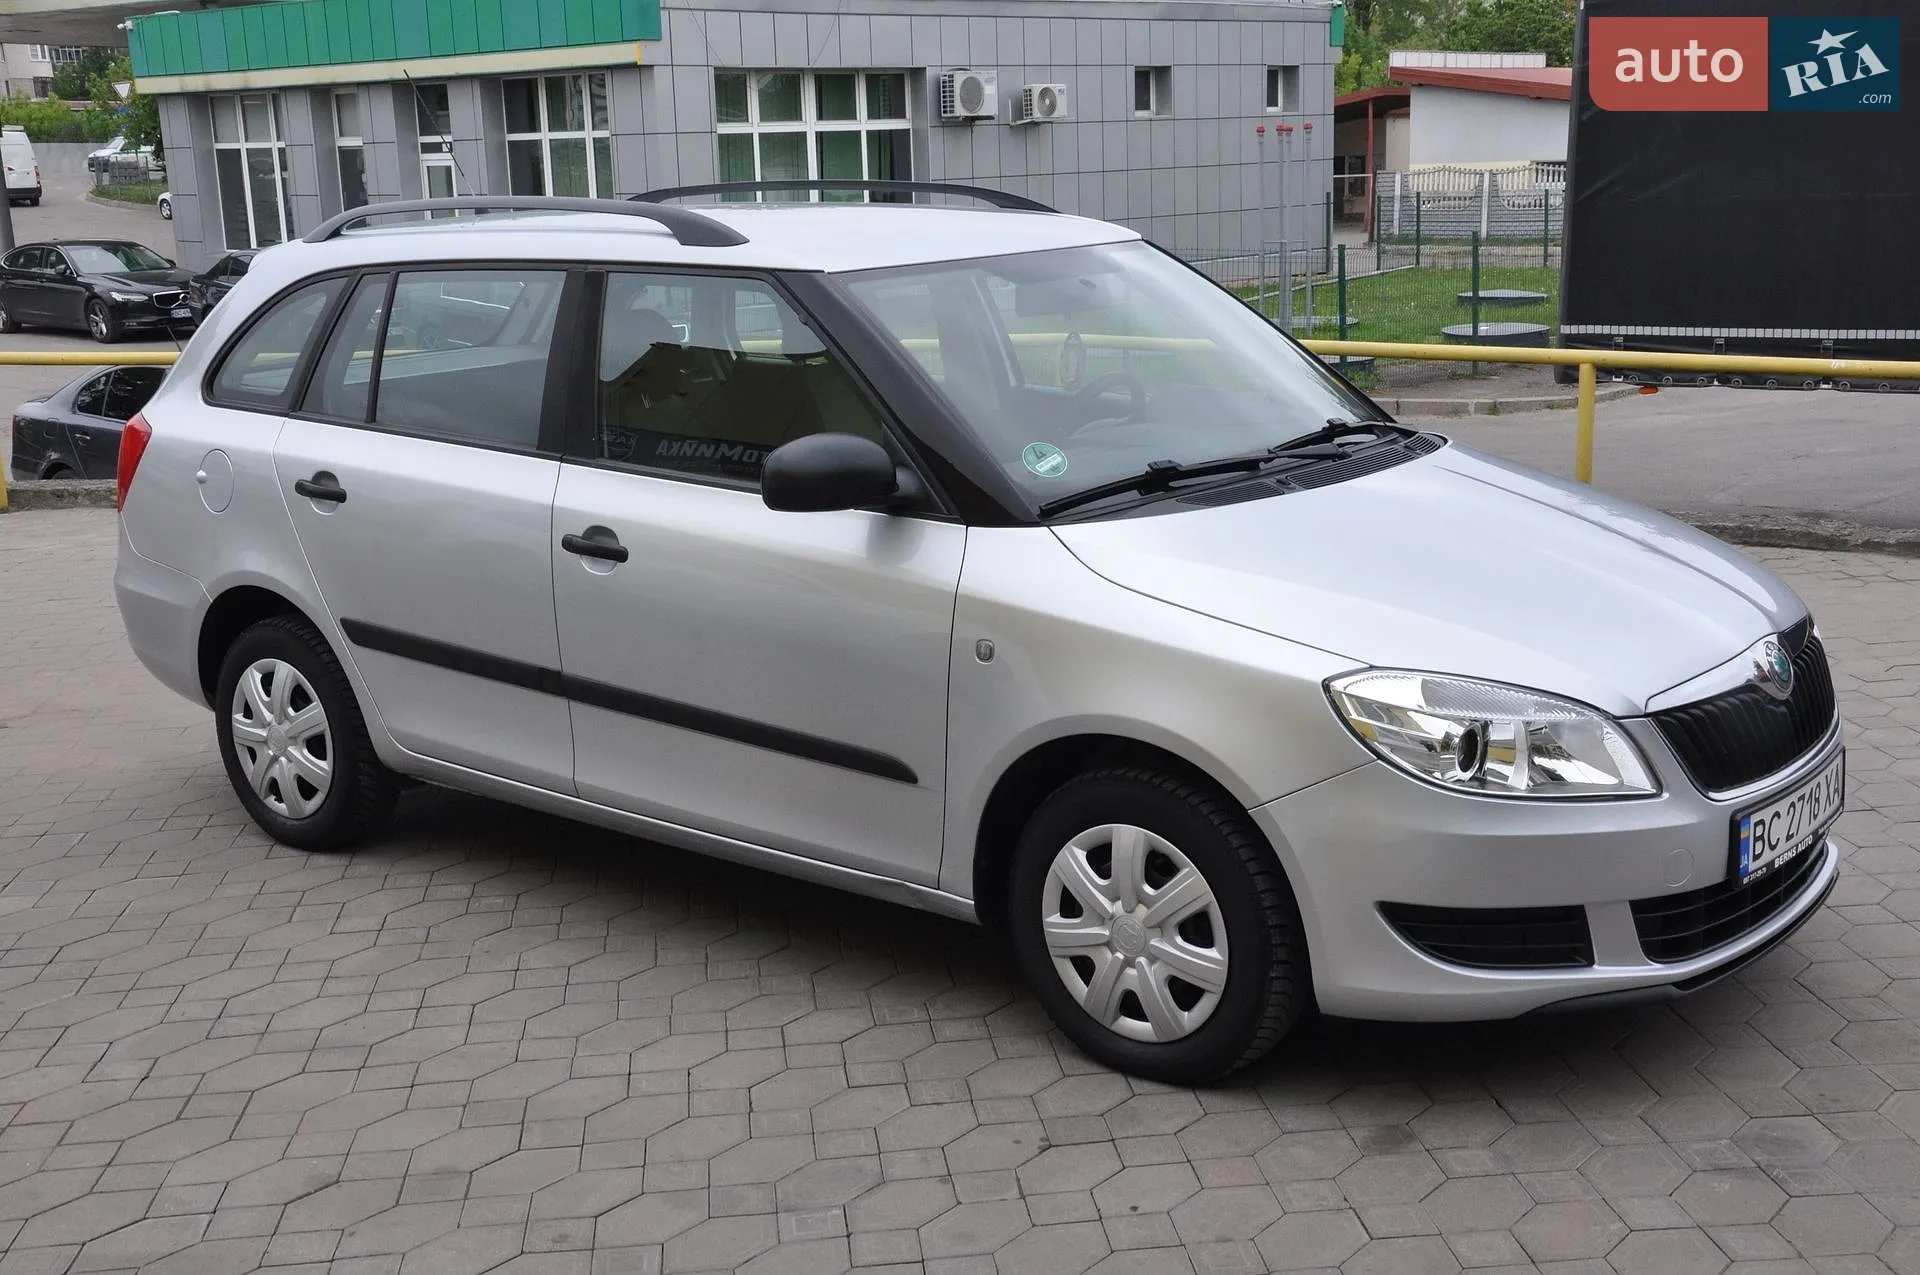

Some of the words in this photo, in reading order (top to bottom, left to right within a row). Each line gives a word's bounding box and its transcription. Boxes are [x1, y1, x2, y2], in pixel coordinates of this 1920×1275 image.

[1752, 811, 1781, 862] BC
[1785, 781, 1821, 844] 2718
[1823, 763, 1841, 814] XA
[1774, 847, 1797, 869] BERNS
[1797, 835, 1813, 853] AUTO
